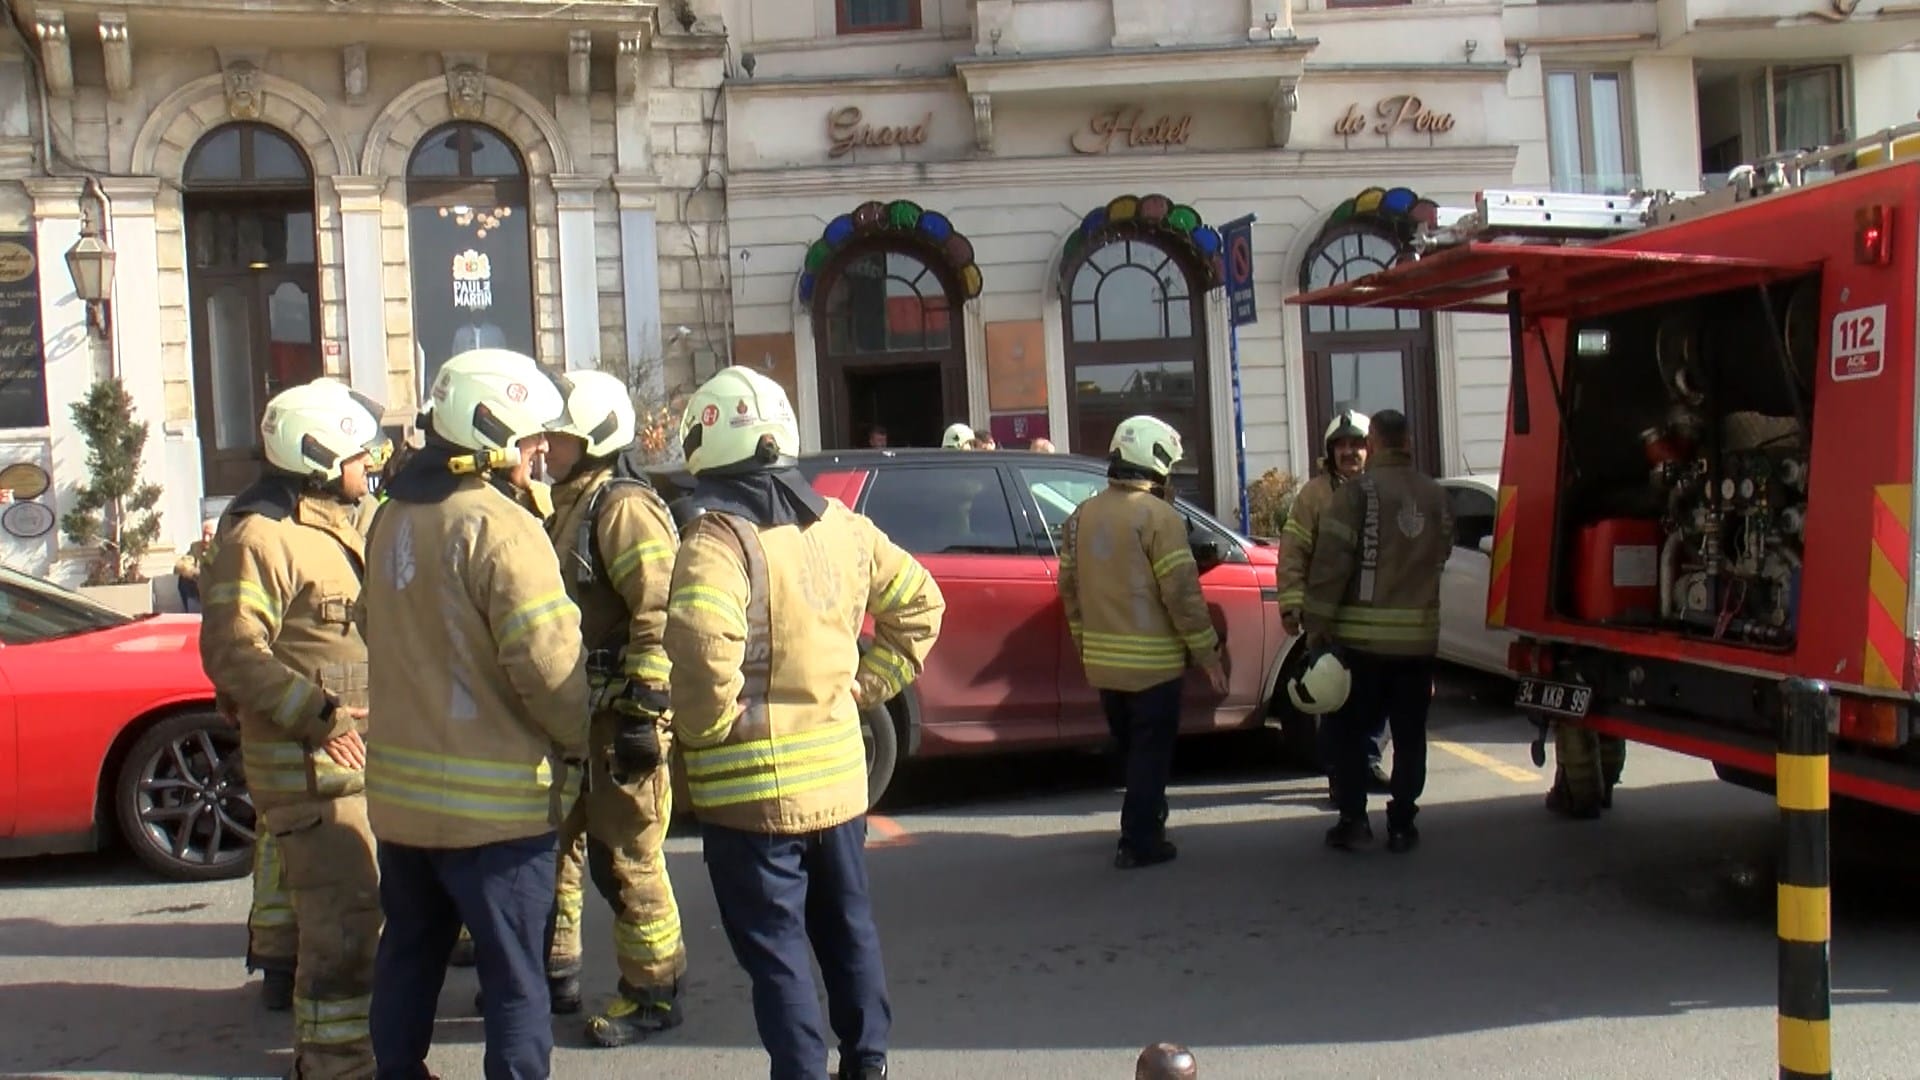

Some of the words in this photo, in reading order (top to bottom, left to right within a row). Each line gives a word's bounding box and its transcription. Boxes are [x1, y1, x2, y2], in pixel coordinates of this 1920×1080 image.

[827, 106, 933, 158] Grand
[1069, 103, 1191, 154] Hotel
[1334, 102, 1366, 135] de
[1374, 94, 1456, 134] Pera
[453, 280, 481, 293] PAUL
[454, 291, 492, 307] MARTIN
[1840, 316, 1875, 351] 112
[1519, 681, 1534, 704] 34
[1541, 684, 1565, 708] KKB
[1570, 689, 1588, 713] 99
